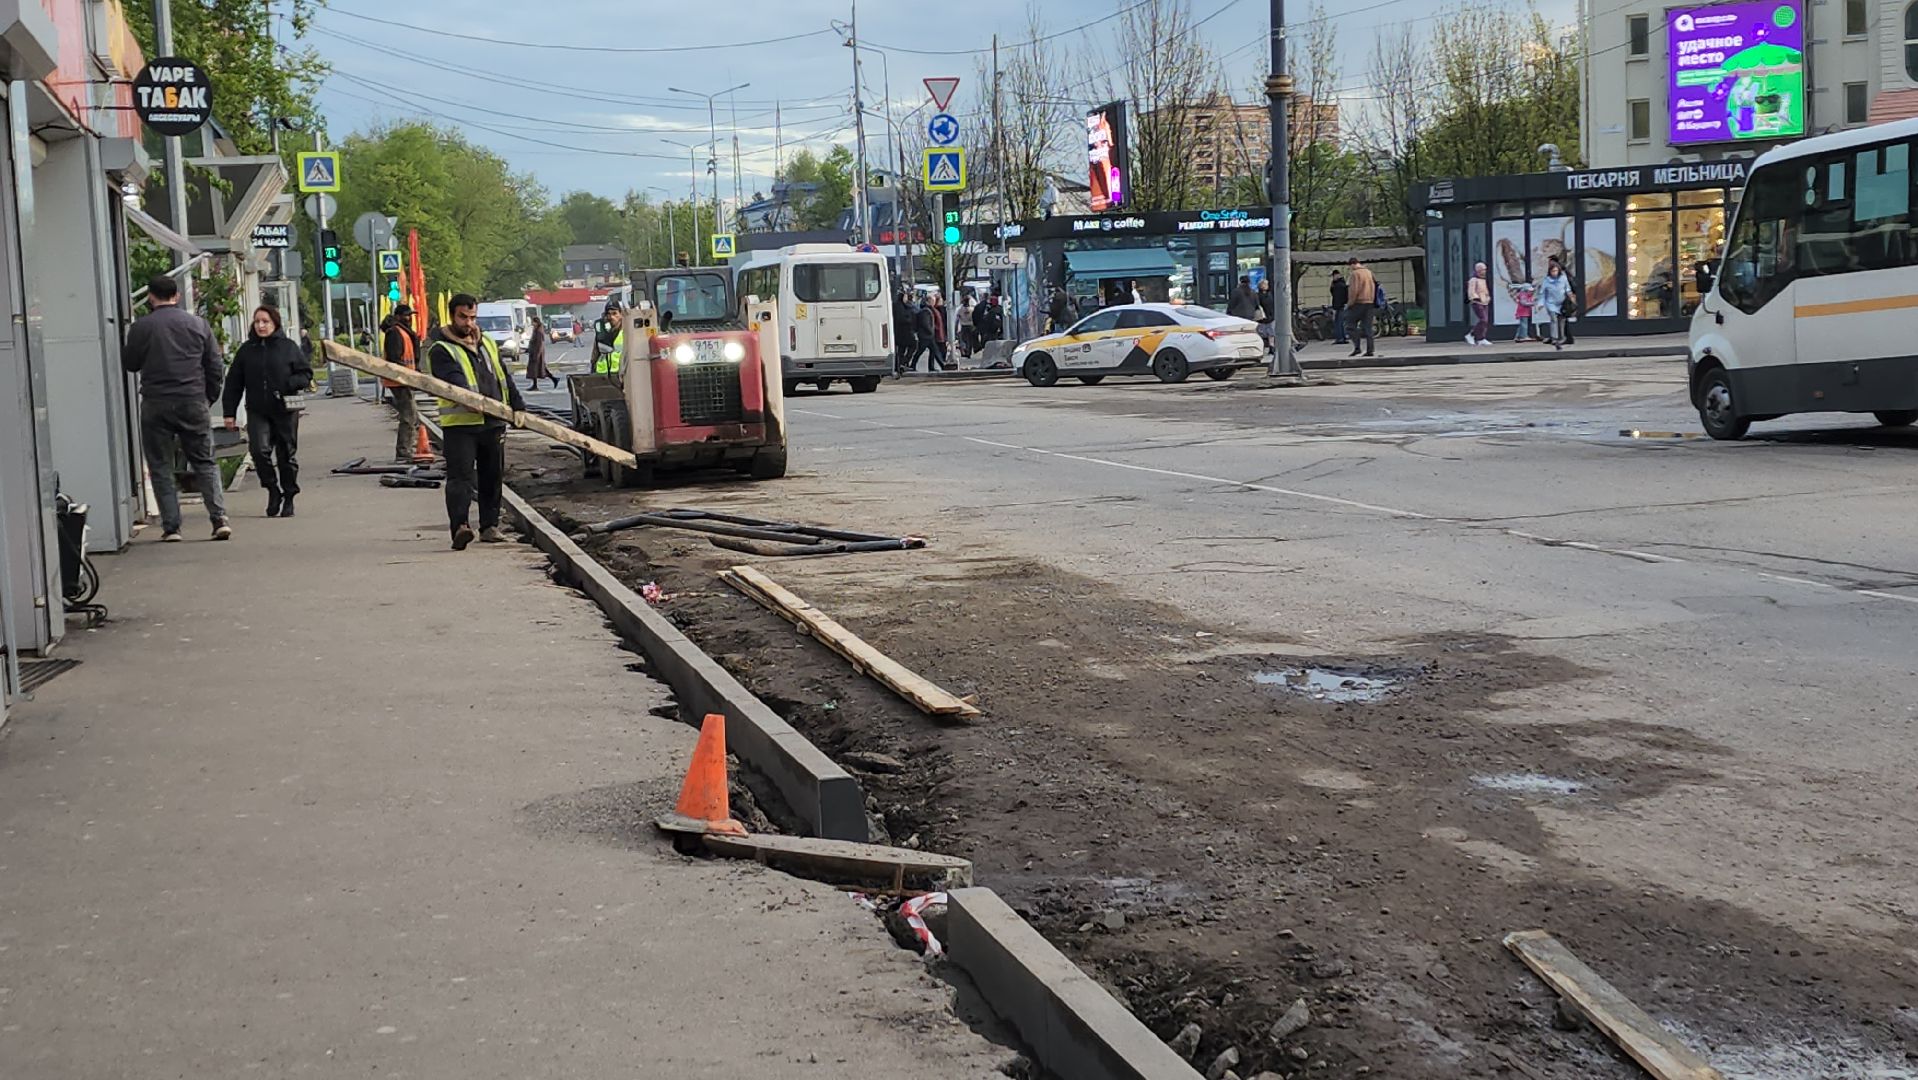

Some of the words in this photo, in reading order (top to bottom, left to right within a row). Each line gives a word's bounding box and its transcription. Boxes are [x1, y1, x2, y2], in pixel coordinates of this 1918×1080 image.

[1677, 35, 1743, 55] удачное
[1678, 52, 1725, 66] место
[149, 66, 195, 82] VAPE
[137, 86, 208, 109] ТАБАК
[1567, 170, 1640, 190] ПЕКАРНЯ
[1654, 163, 1746, 184] МЕЛЬНИЦА
